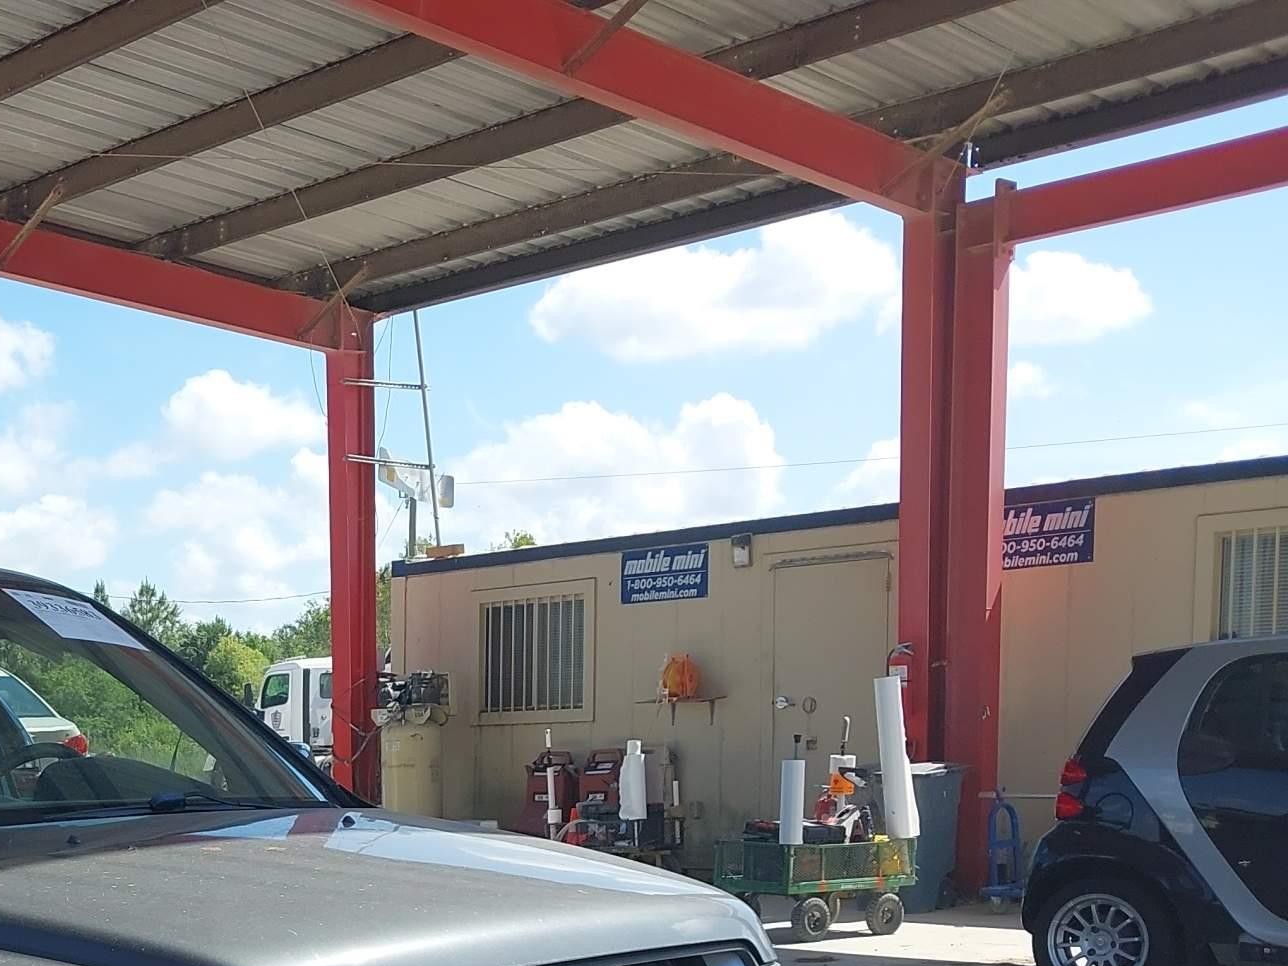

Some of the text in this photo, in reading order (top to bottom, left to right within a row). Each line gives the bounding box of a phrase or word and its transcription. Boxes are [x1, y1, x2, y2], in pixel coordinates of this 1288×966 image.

[1002, 504, 1091, 536] bile mini
[1002, 534, 1084, 554] 00-950-6464
[624, 549, 706, 575] mobile mini
[1003, 552, 1078, 568] bilemini.com
[626, 573, 702, 592] 1-800-950-6464
[631, 588, 698, 602] mobilemini.com
